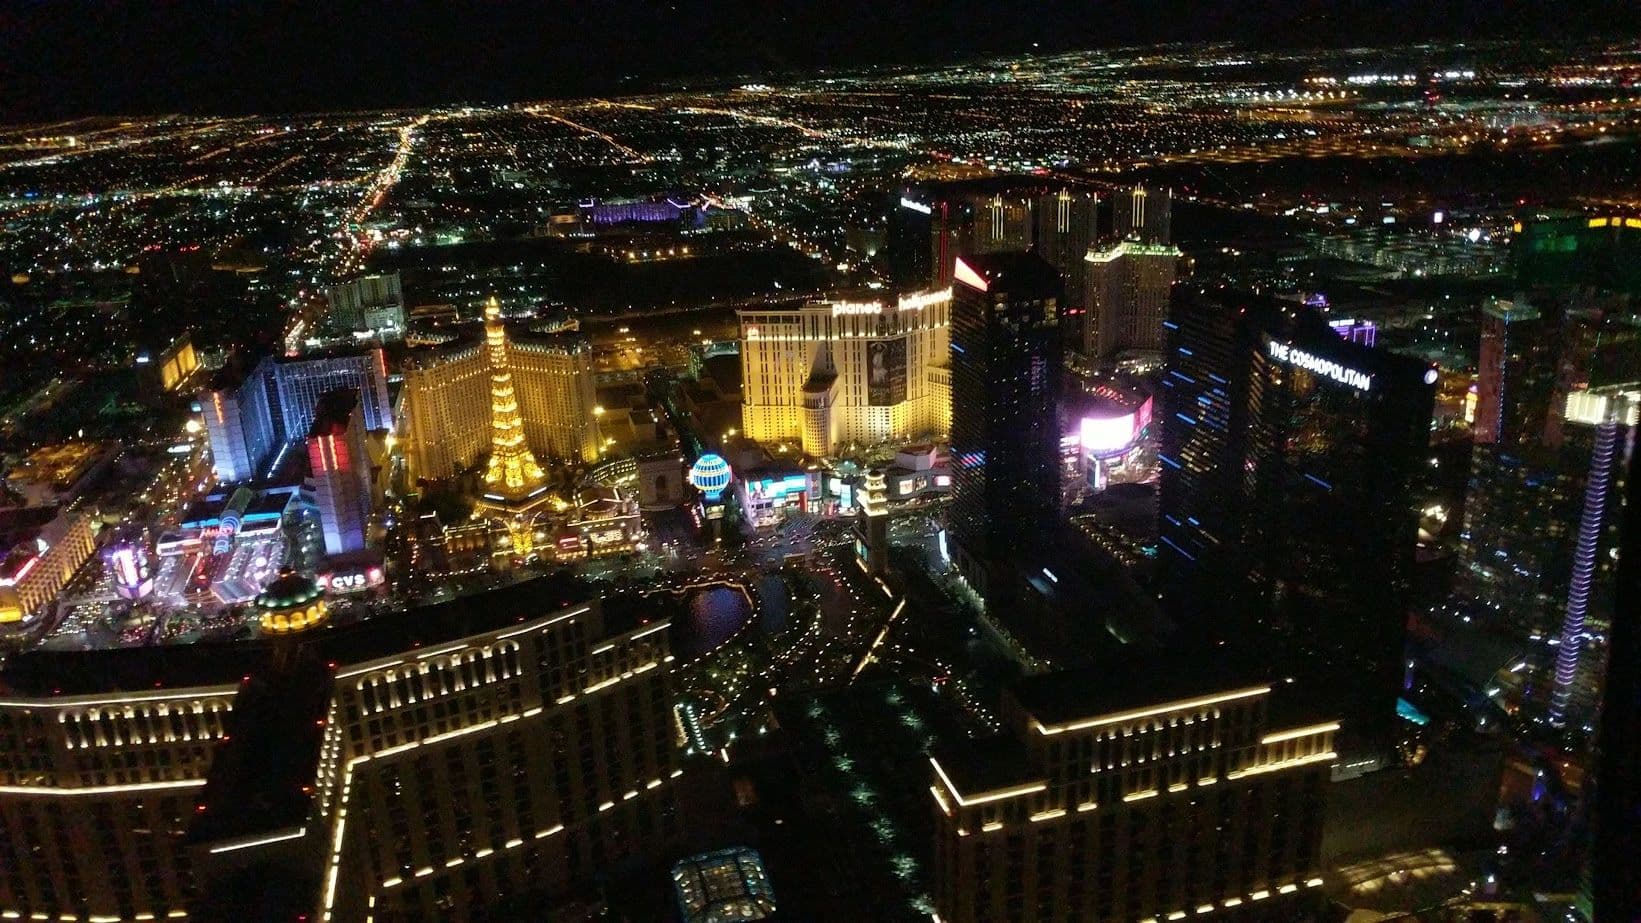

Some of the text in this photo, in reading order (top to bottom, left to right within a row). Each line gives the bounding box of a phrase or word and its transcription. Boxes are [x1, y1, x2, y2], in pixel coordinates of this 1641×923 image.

[833, 301, 882, 318] planet
[1270, 341, 1371, 391] THE COSMOPOLITAN
[332, 574, 365, 587] CVS
